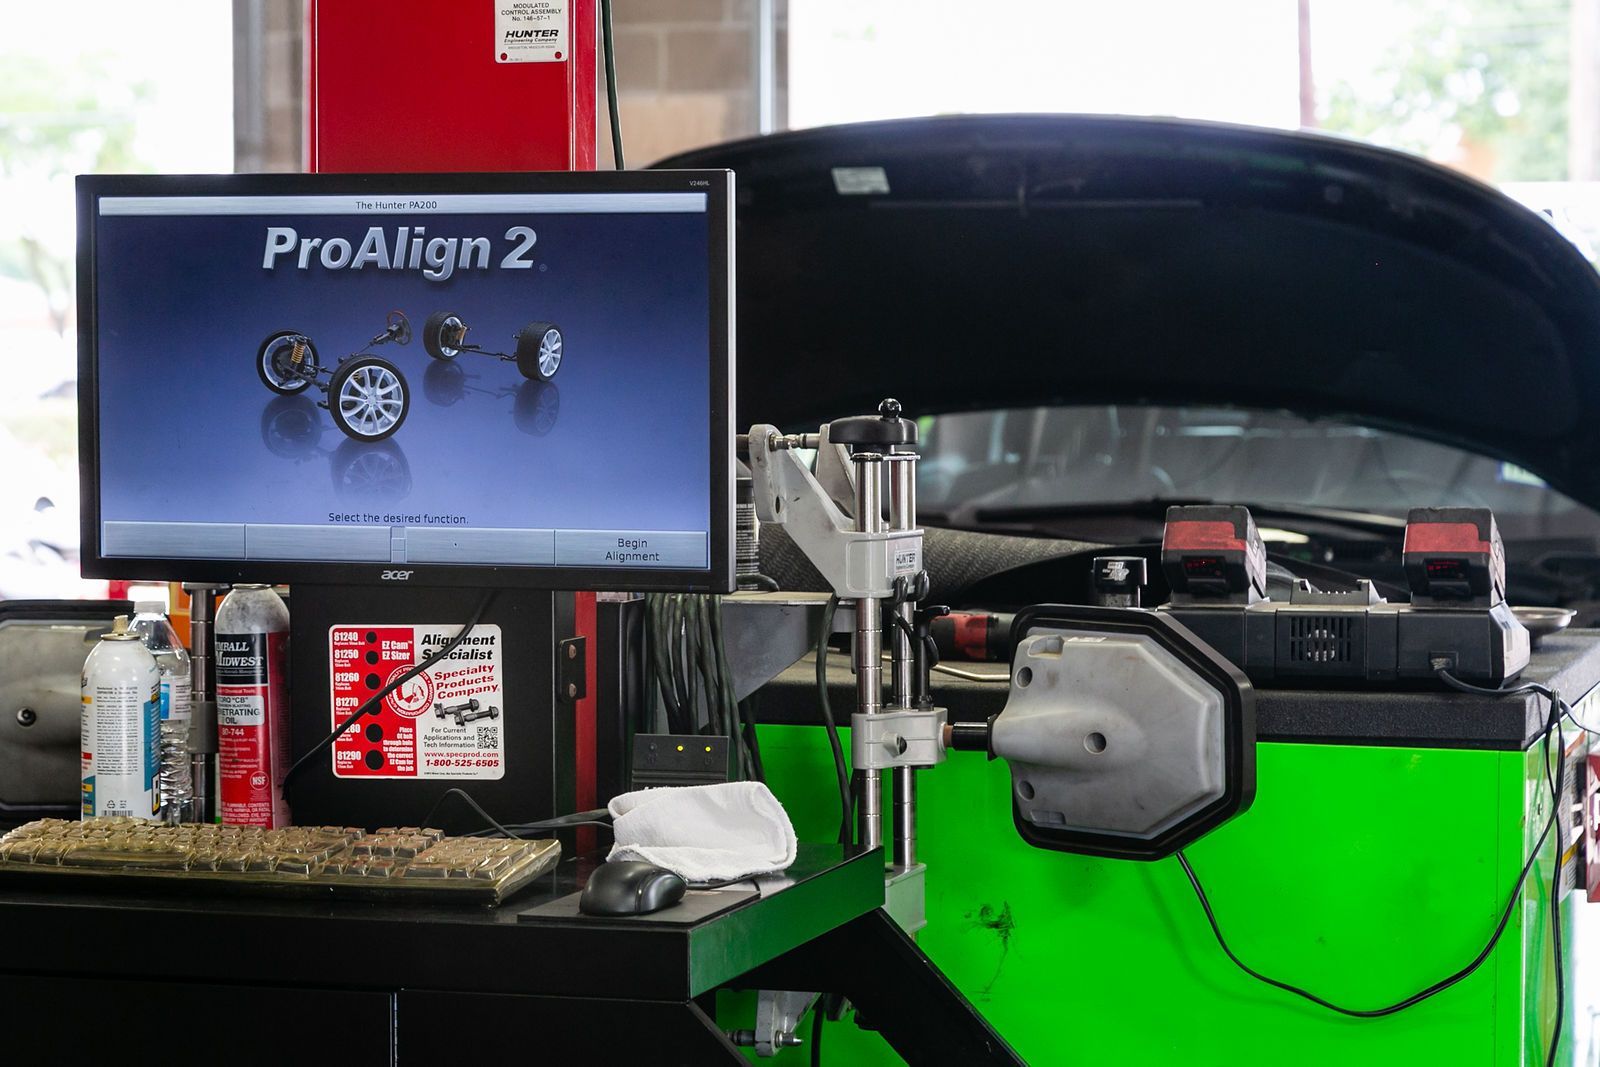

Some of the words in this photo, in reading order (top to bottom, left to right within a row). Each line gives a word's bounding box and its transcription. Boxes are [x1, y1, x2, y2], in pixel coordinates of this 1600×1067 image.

[505, 30, 559, 38] HUNTER
[356, 201, 372, 209] The
[375, 201, 406, 209] Hunter
[409, 201, 437, 209] PA200
[262, 226, 491, 281] ProAlign
[500, 226, 537, 269] 2
[328, 513, 361, 522] Select
[363, 513, 380, 523] the
[383, 514, 421, 523] desired
[424, 514, 469, 524] function.
[618, 538, 648, 550] Begin
[605, 552, 660, 563] Alignment
[381, 570, 414, 580] acer
[334, 632, 359, 641] 81240
[421, 634, 496, 648] Aligment
[382, 641, 390, 650] EZ
[334, 649, 359, 658] 81250
[382, 651, 390, 660] EZ
[391, 651, 410, 660] Sizer
[335, 672, 359, 682] 81260
[434, 665, 495, 680] Specialty
[436, 675, 494, 690] Products
[438, 684, 498, 699] Company
[336, 697, 358, 707] 81270
[218, 708, 260, 716] ETRATING
[225, 717, 237, 725] OIL
[337, 723, 361, 733] 280
[337, 751, 361, 761] 81290
[252, 777, 266, 785] NSF
